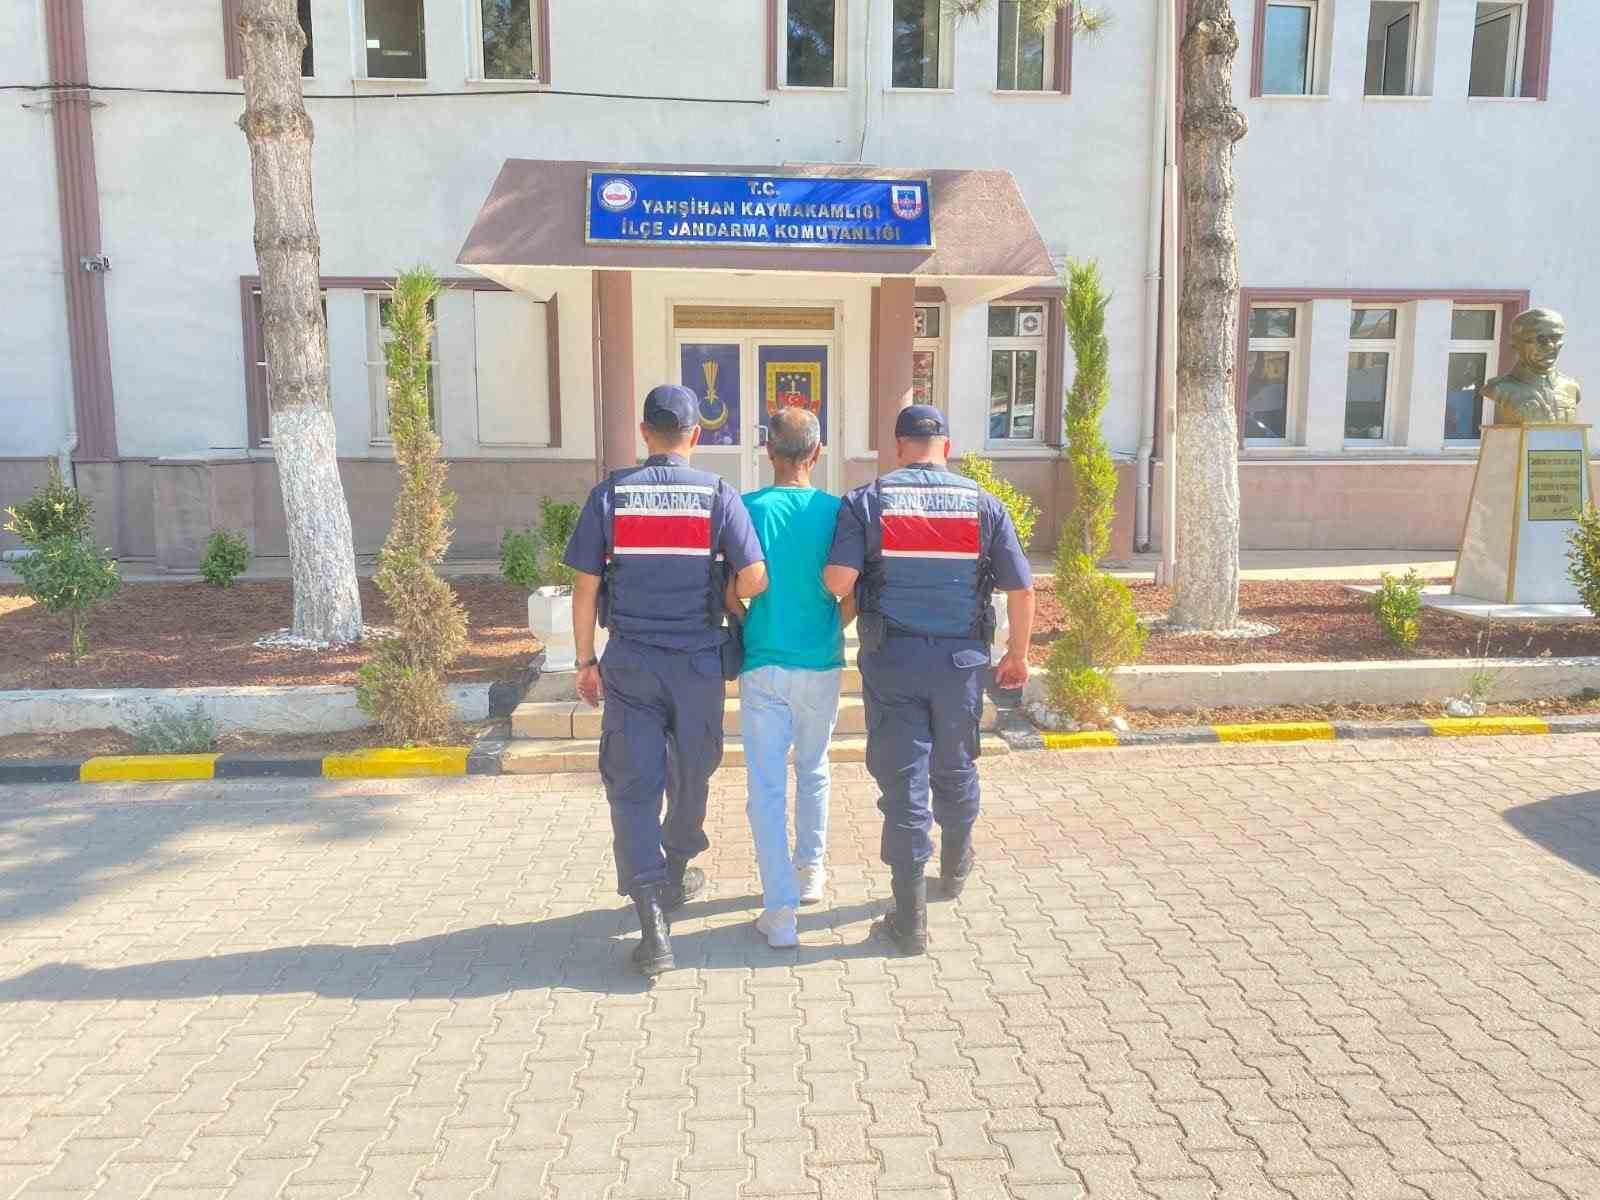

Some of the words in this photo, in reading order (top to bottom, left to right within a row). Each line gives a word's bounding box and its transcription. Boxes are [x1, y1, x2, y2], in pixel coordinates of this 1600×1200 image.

[749, 180, 780, 197] T.C.
[641, 197, 735, 218] YAHŞİHAN
[741, 201, 881, 220] KAYMAKAMLIĞI
[621, 217, 664, 239] İLÇE
[668, 221, 769, 238] JANDARMA
[775, 223, 900, 241] KOMUTANLIĞI
[625, 492, 702, 511] JANDARMA
[890, 492, 970, 511] JANDARMA
